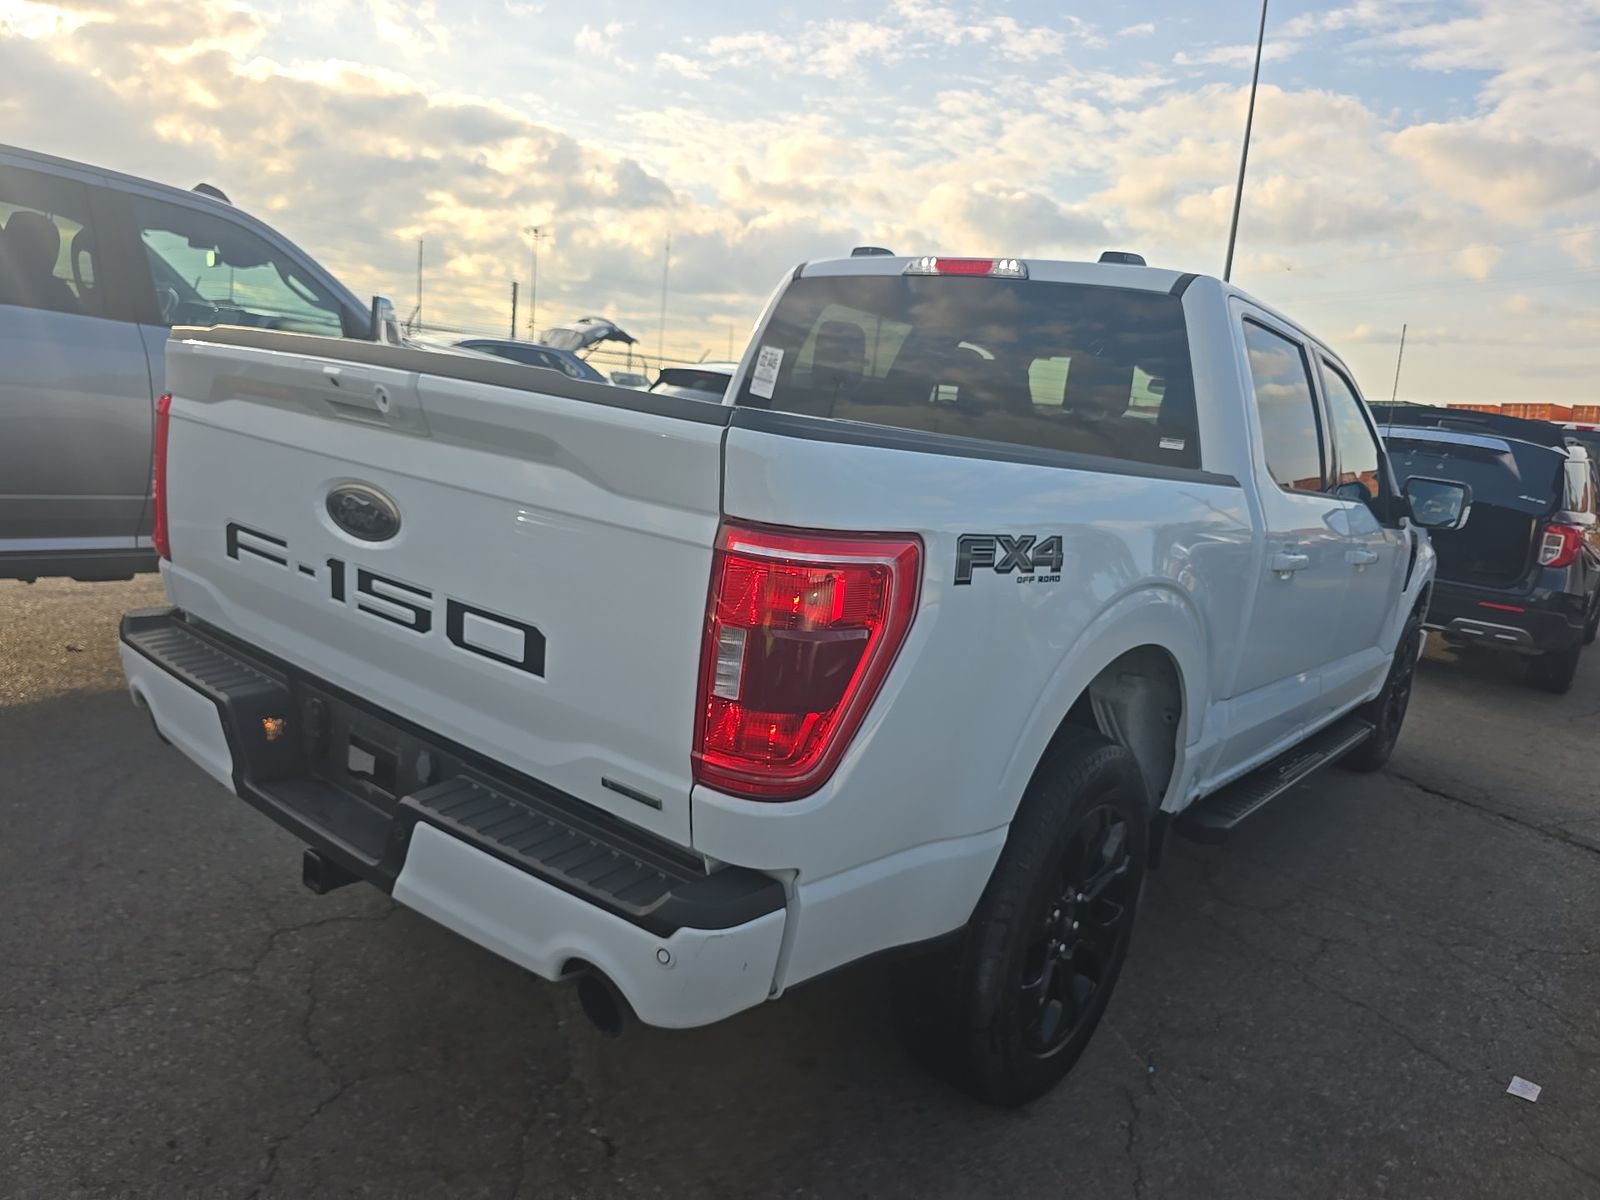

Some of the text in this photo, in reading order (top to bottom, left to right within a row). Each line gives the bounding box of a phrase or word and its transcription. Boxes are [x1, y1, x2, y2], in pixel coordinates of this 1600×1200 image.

[953, 533, 1064, 586] FX4
[1016, 575, 1061, 584] OFF ROAD
[226, 521, 547, 679] F-150
